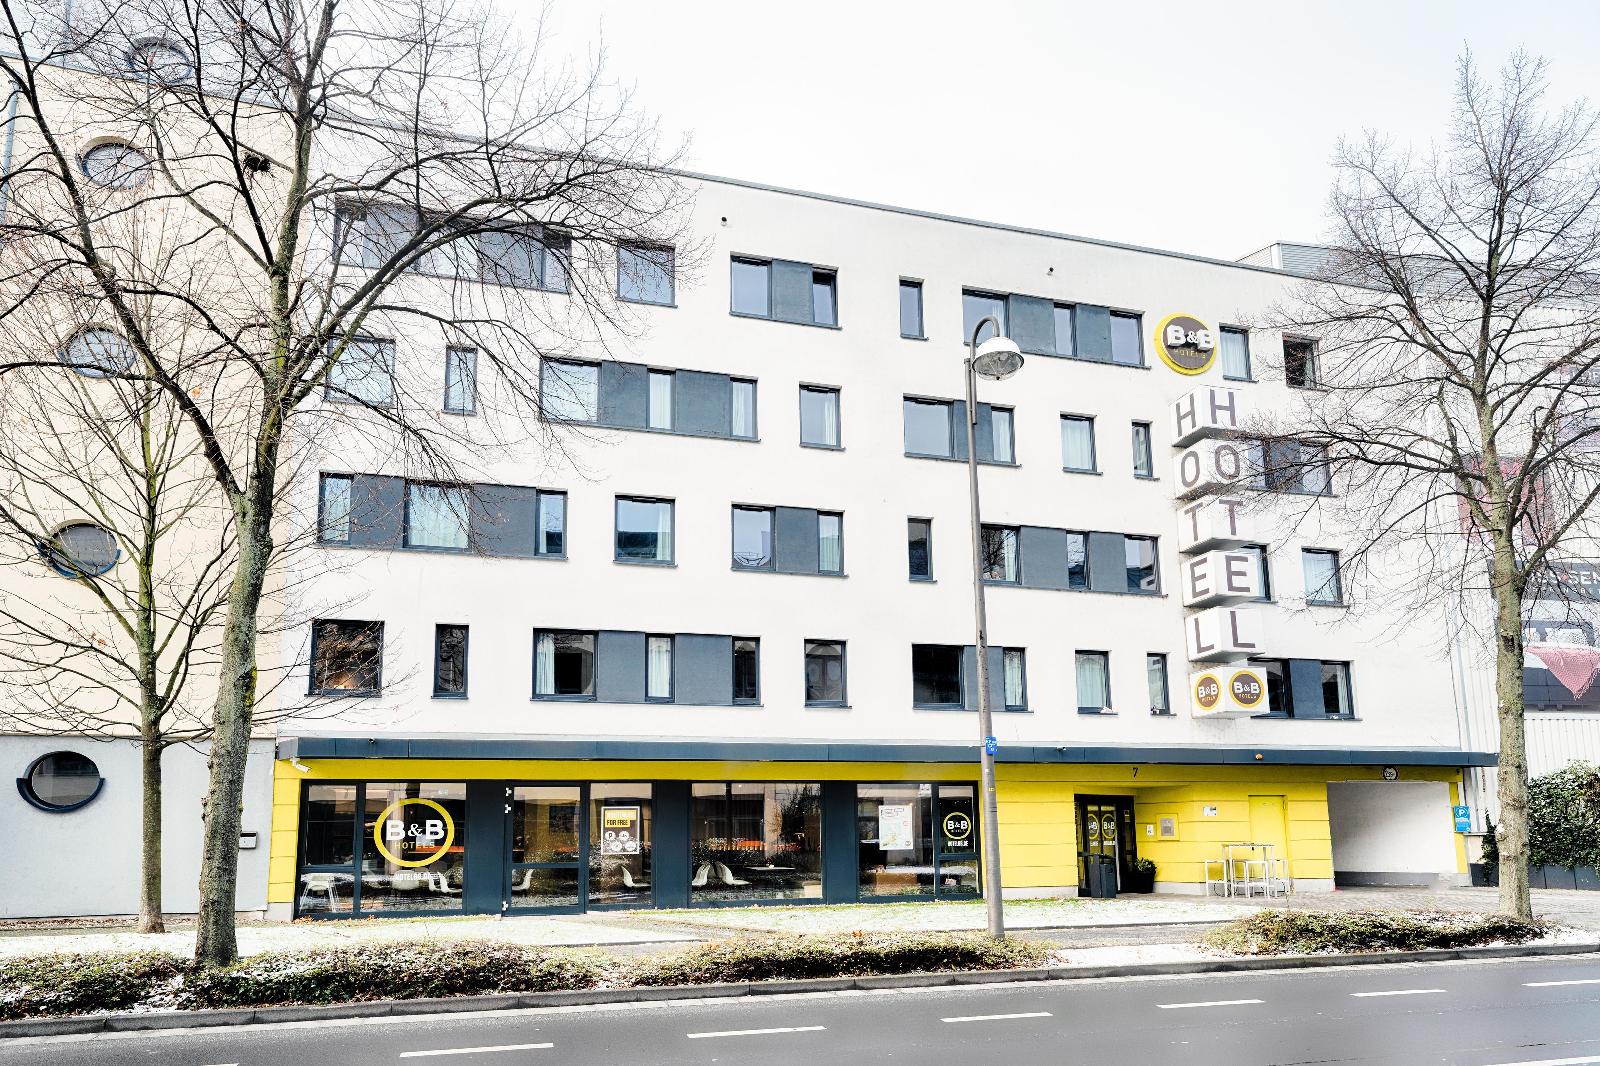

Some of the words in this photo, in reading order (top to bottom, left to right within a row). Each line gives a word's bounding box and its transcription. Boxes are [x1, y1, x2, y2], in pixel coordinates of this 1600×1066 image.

[1166, 325, 1215, 351] B&B
[1198, 683, 1218, 698] B&B
[1233, 681, 1260, 694] B&B
[1132, 767, 1139, 778] 7
[1458, 808, 1466, 816] P
[386, 819, 445, 841] B&B
[947, 820, 968, 830] B&B
